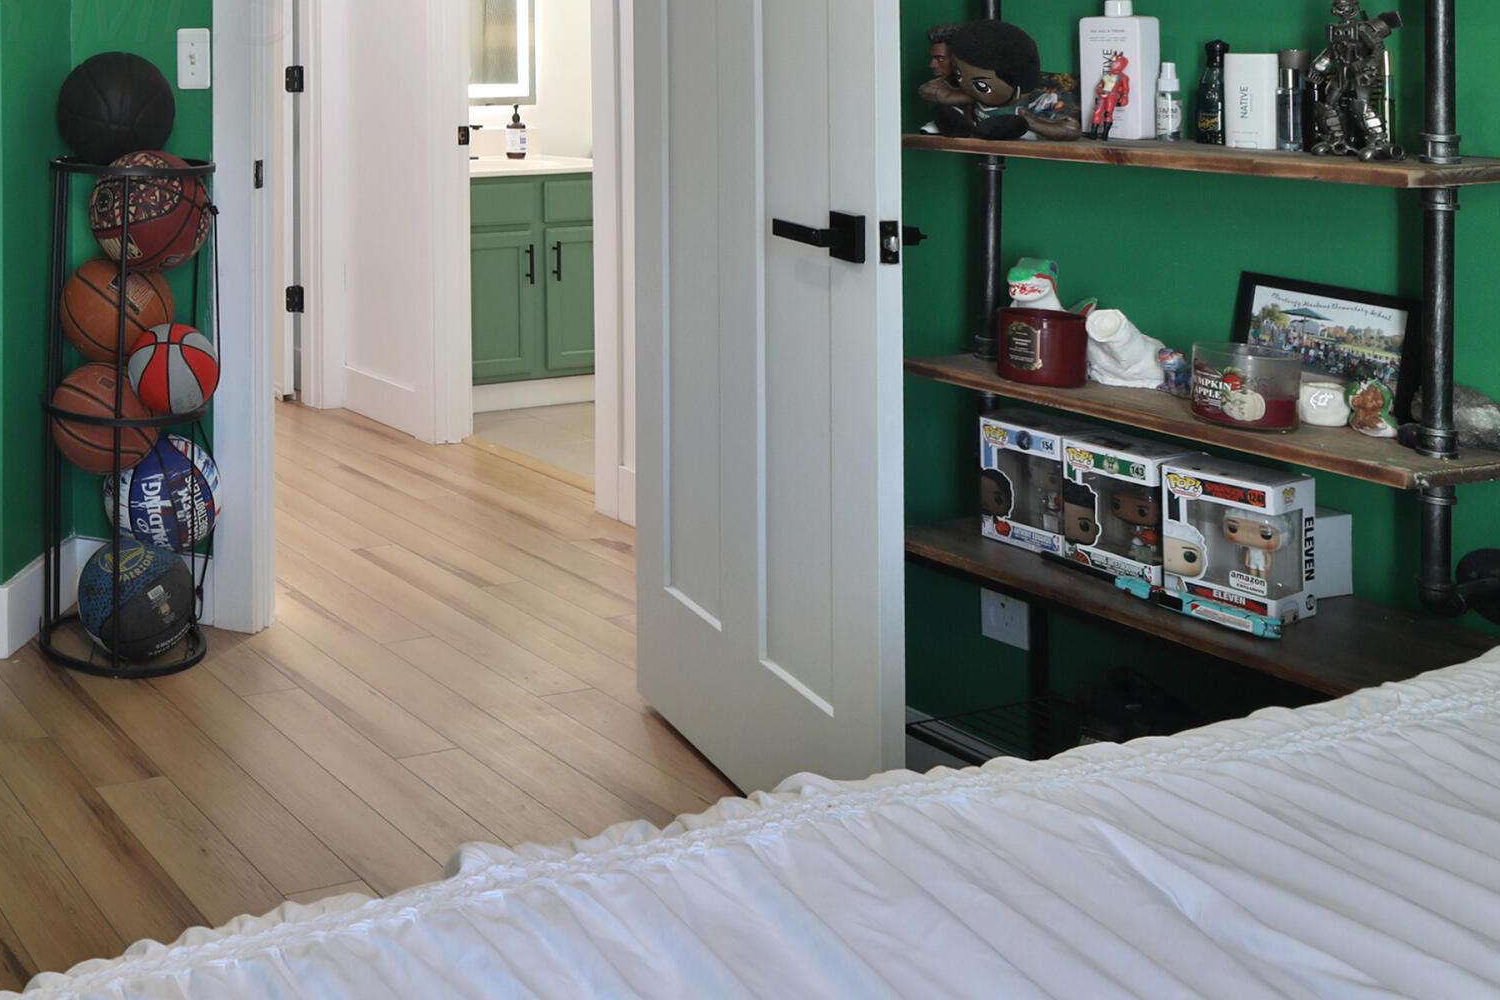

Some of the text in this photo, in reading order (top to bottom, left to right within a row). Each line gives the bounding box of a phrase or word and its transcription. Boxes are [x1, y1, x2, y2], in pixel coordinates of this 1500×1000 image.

[1102, 49, 1112, 75] TIVE
[1240, 85, 1248, 120] NATIVE
[1041, 440, 1053, 451] 154
[1131, 465, 1145, 477] 143
[1166, 473, 1202, 492] POP!
[1304, 516, 1315, 581] ELEVEN
[119, 550, 156, 583] ARRIORS
[1231, 570, 1266, 587] amazon
[1213, 589, 1246, 606] ELEVEN
